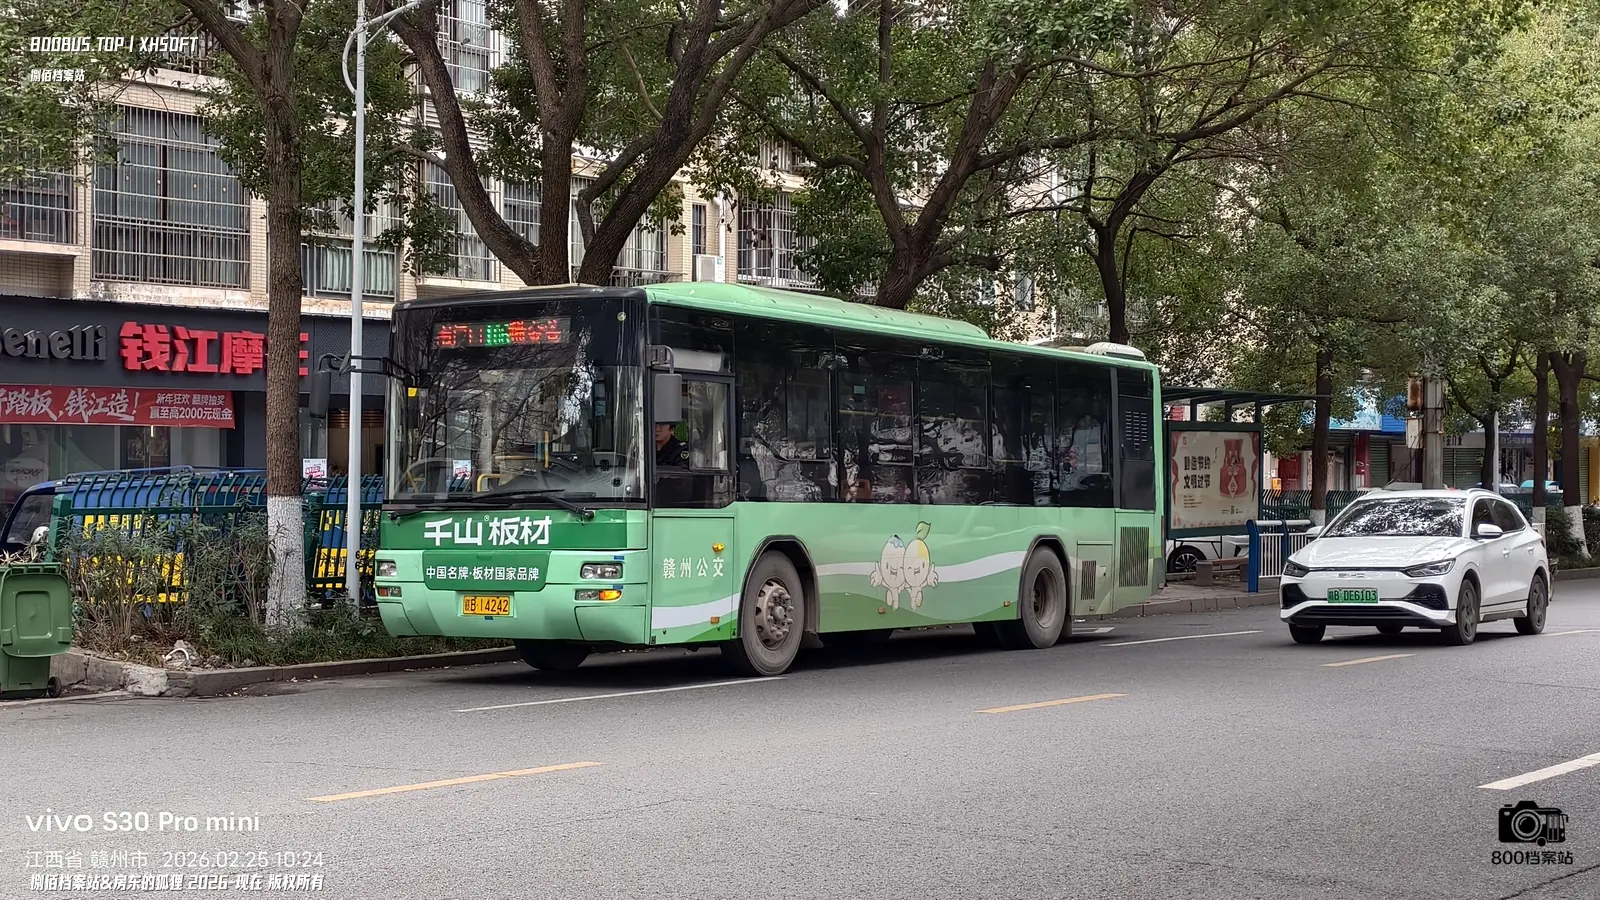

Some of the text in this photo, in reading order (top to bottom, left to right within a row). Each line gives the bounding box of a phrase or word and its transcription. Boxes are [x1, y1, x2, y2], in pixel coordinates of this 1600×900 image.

[0, 324, 107, 360] enelli
[663, 557, 724, 578] 赣州公交
